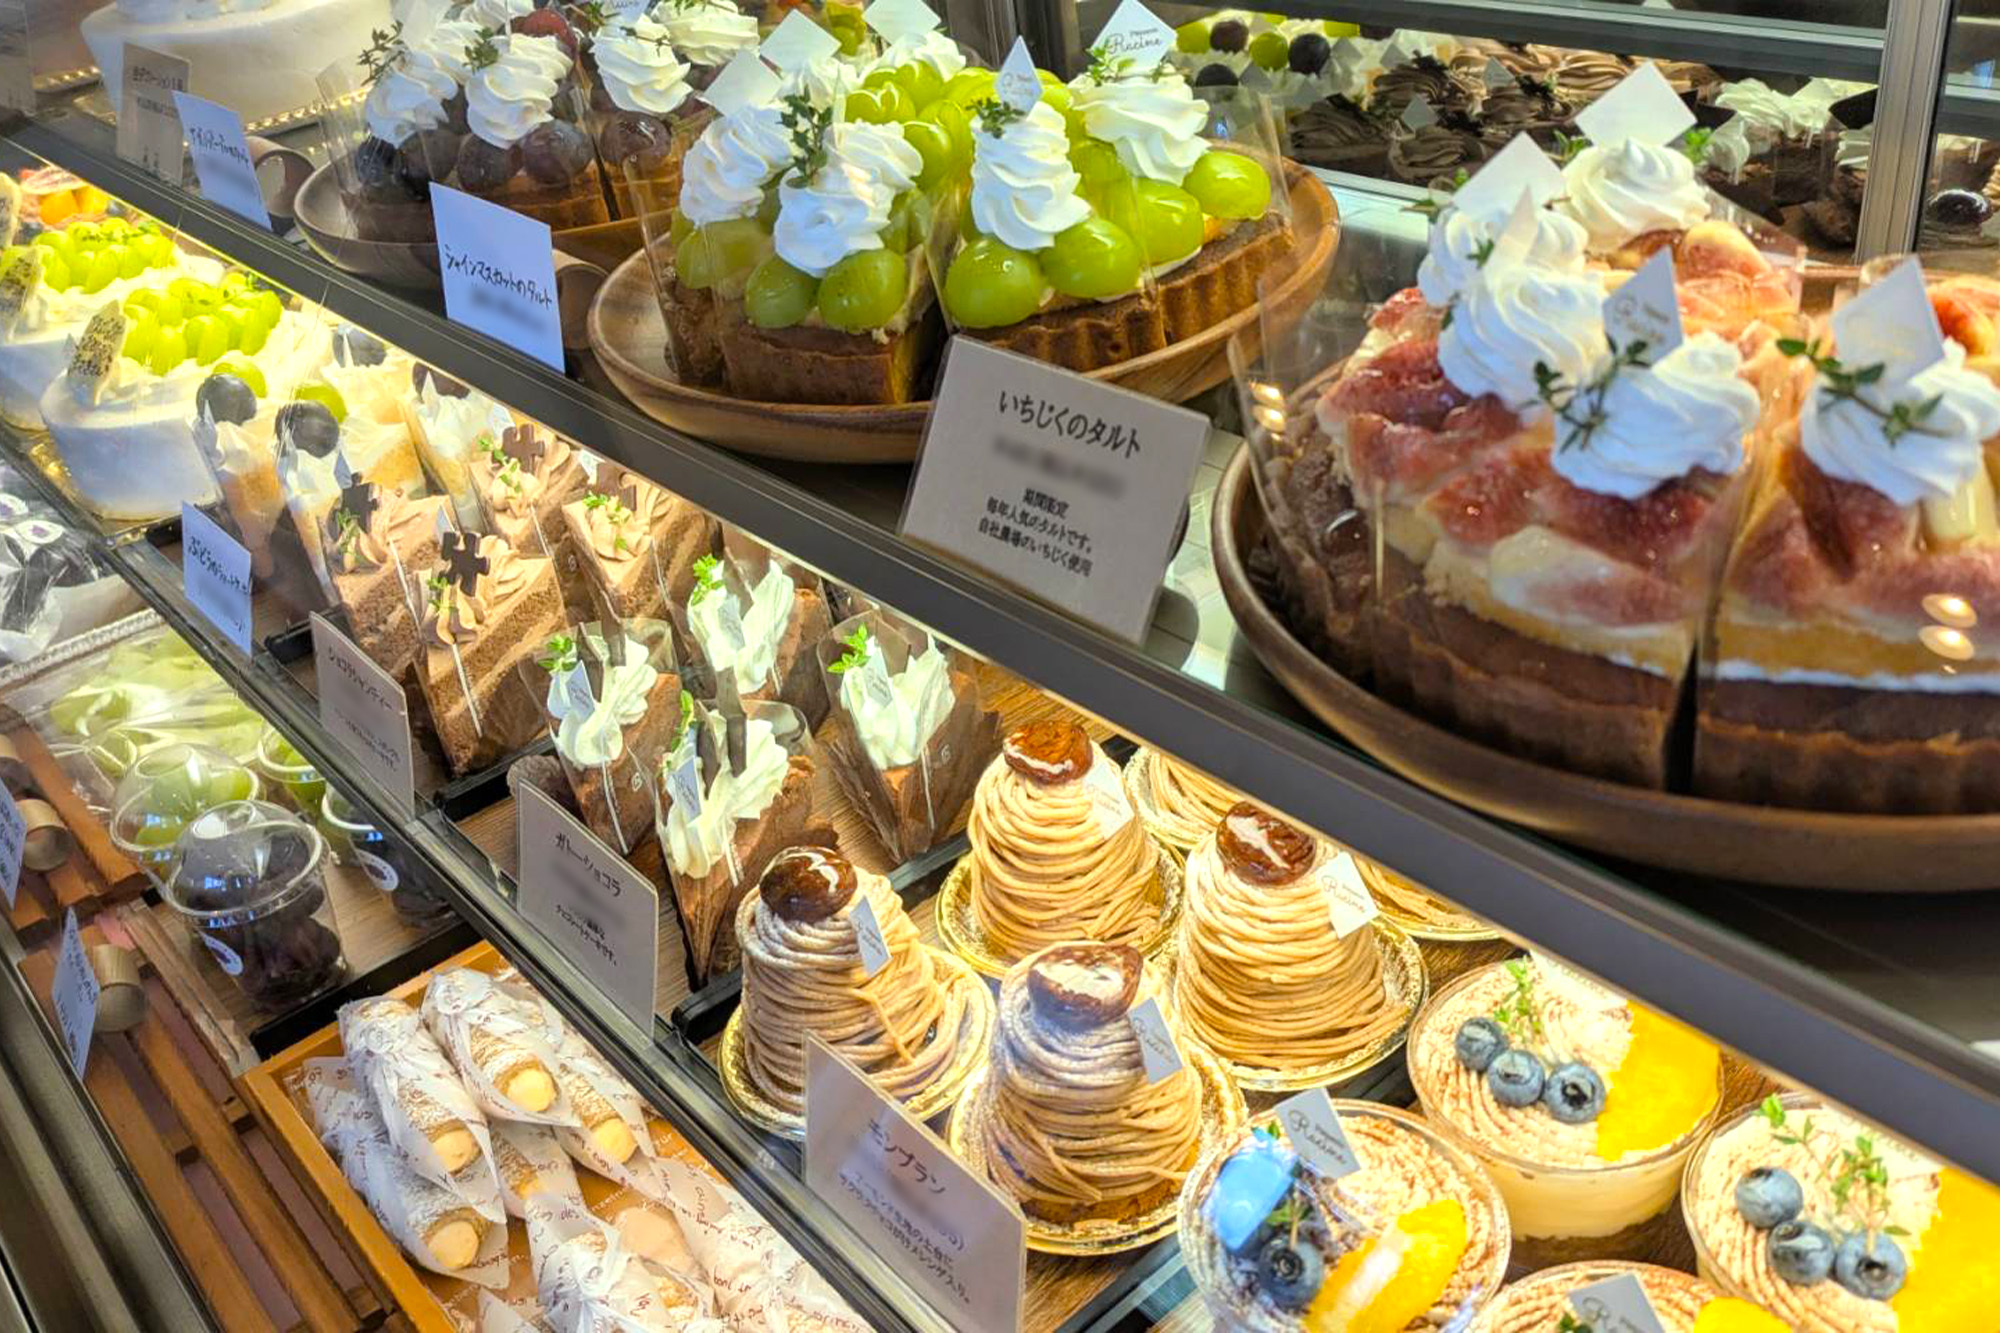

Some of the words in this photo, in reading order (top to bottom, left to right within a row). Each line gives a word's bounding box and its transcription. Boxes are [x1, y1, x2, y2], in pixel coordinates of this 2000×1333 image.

[1104, 33, 1161, 55] Racine
[999, 391, 1141, 459] いちじくのタルト
[555, 832, 622, 898] ガトーショコラ
[869, 1119, 946, 1195] モンブラン
